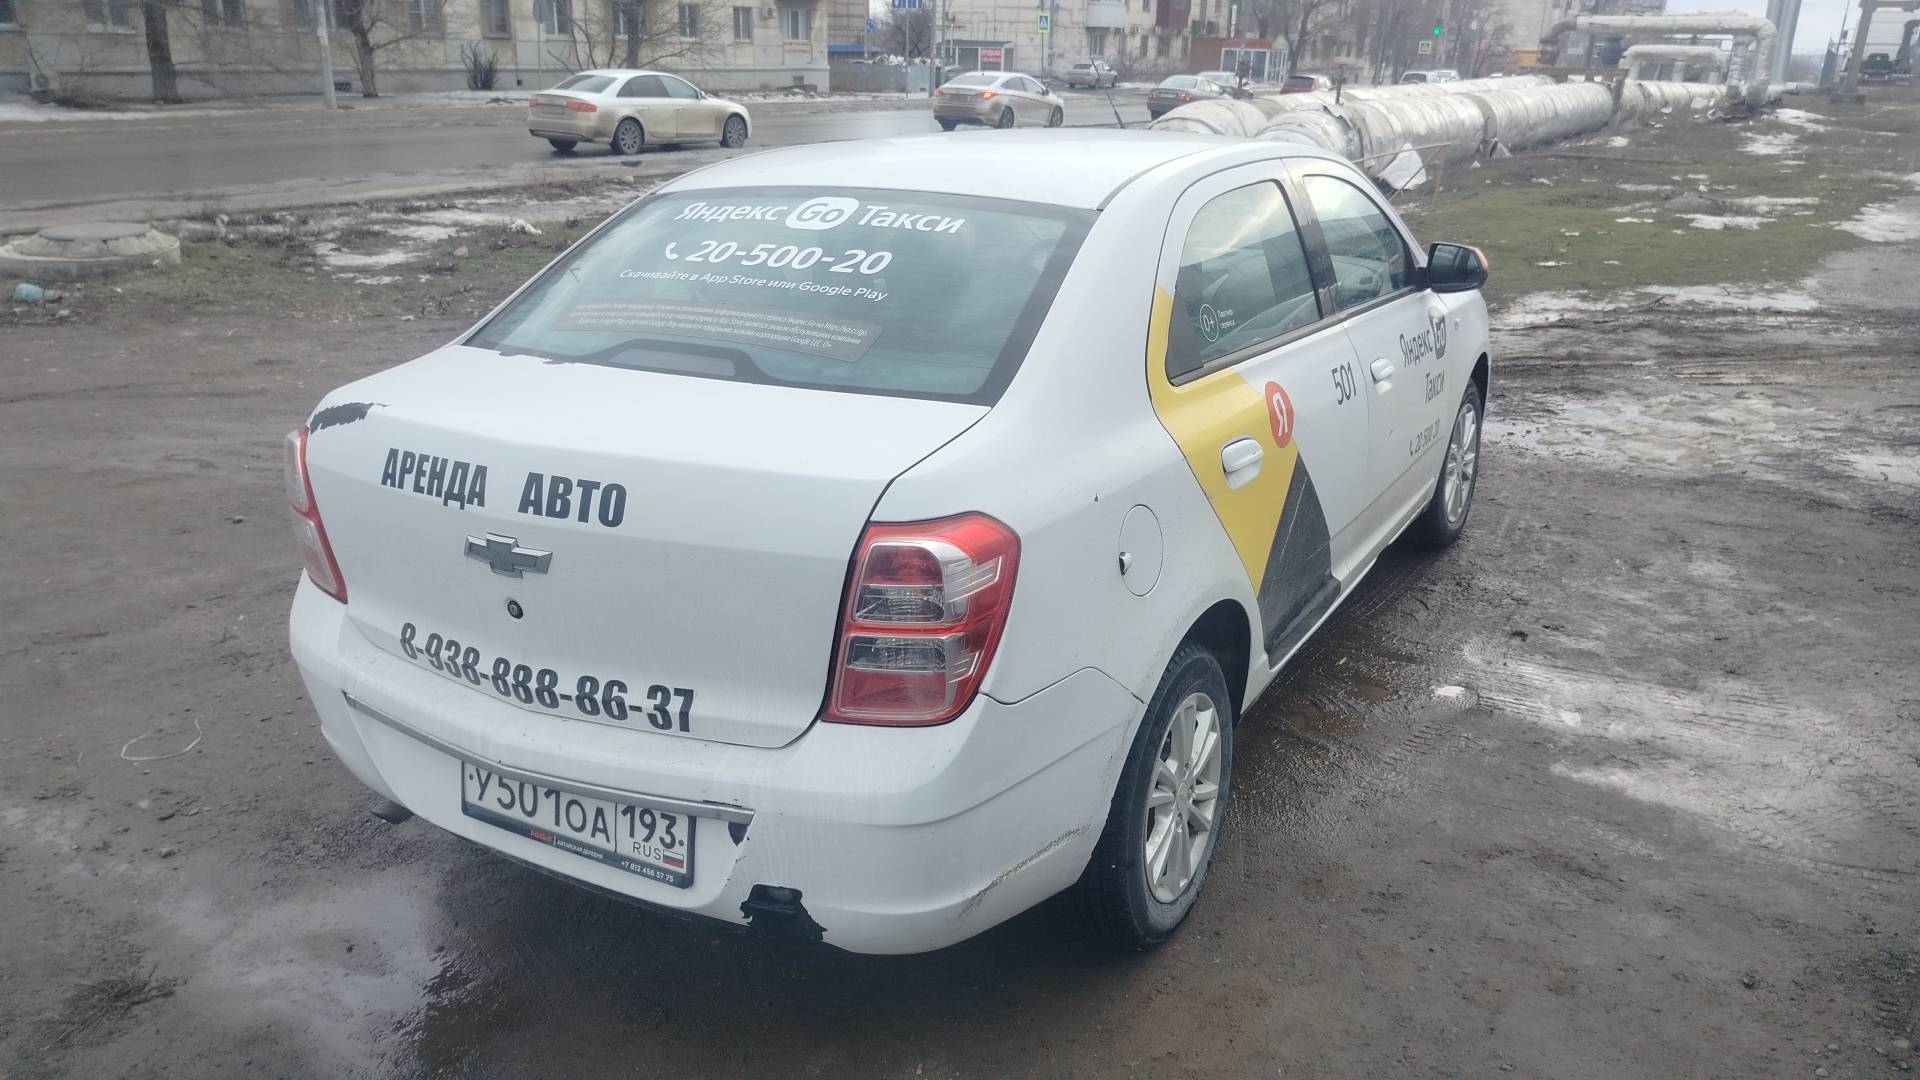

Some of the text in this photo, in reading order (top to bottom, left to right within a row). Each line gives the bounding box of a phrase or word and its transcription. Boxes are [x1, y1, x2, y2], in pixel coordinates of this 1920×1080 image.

[674, 202, 788, 223] Яндекс
[857, 205, 966, 234] Такси
[684, 240, 893, 275] 20-500-20
[619, 269, 689, 281] Скачивайте
[699, 272, 728, 285] App
[729, 275, 767, 287] Store
[768, 280, 797, 290] или
[799, 281, 851, 297] Google
[853, 287, 888, 302] Play
[1399, 329, 1433, 368] Яндекс
[1331, 361, 1357, 405] 501
[1425, 369, 1445, 404] Такси
[380, 447, 628, 529] АРЕНДА АВТО
[399, 621, 696, 733] 8-938-888-86-37
[620, 804, 678, 850] 193
[630, 861, 642, 872] 812
[632, 841, 663, 861] RUS
